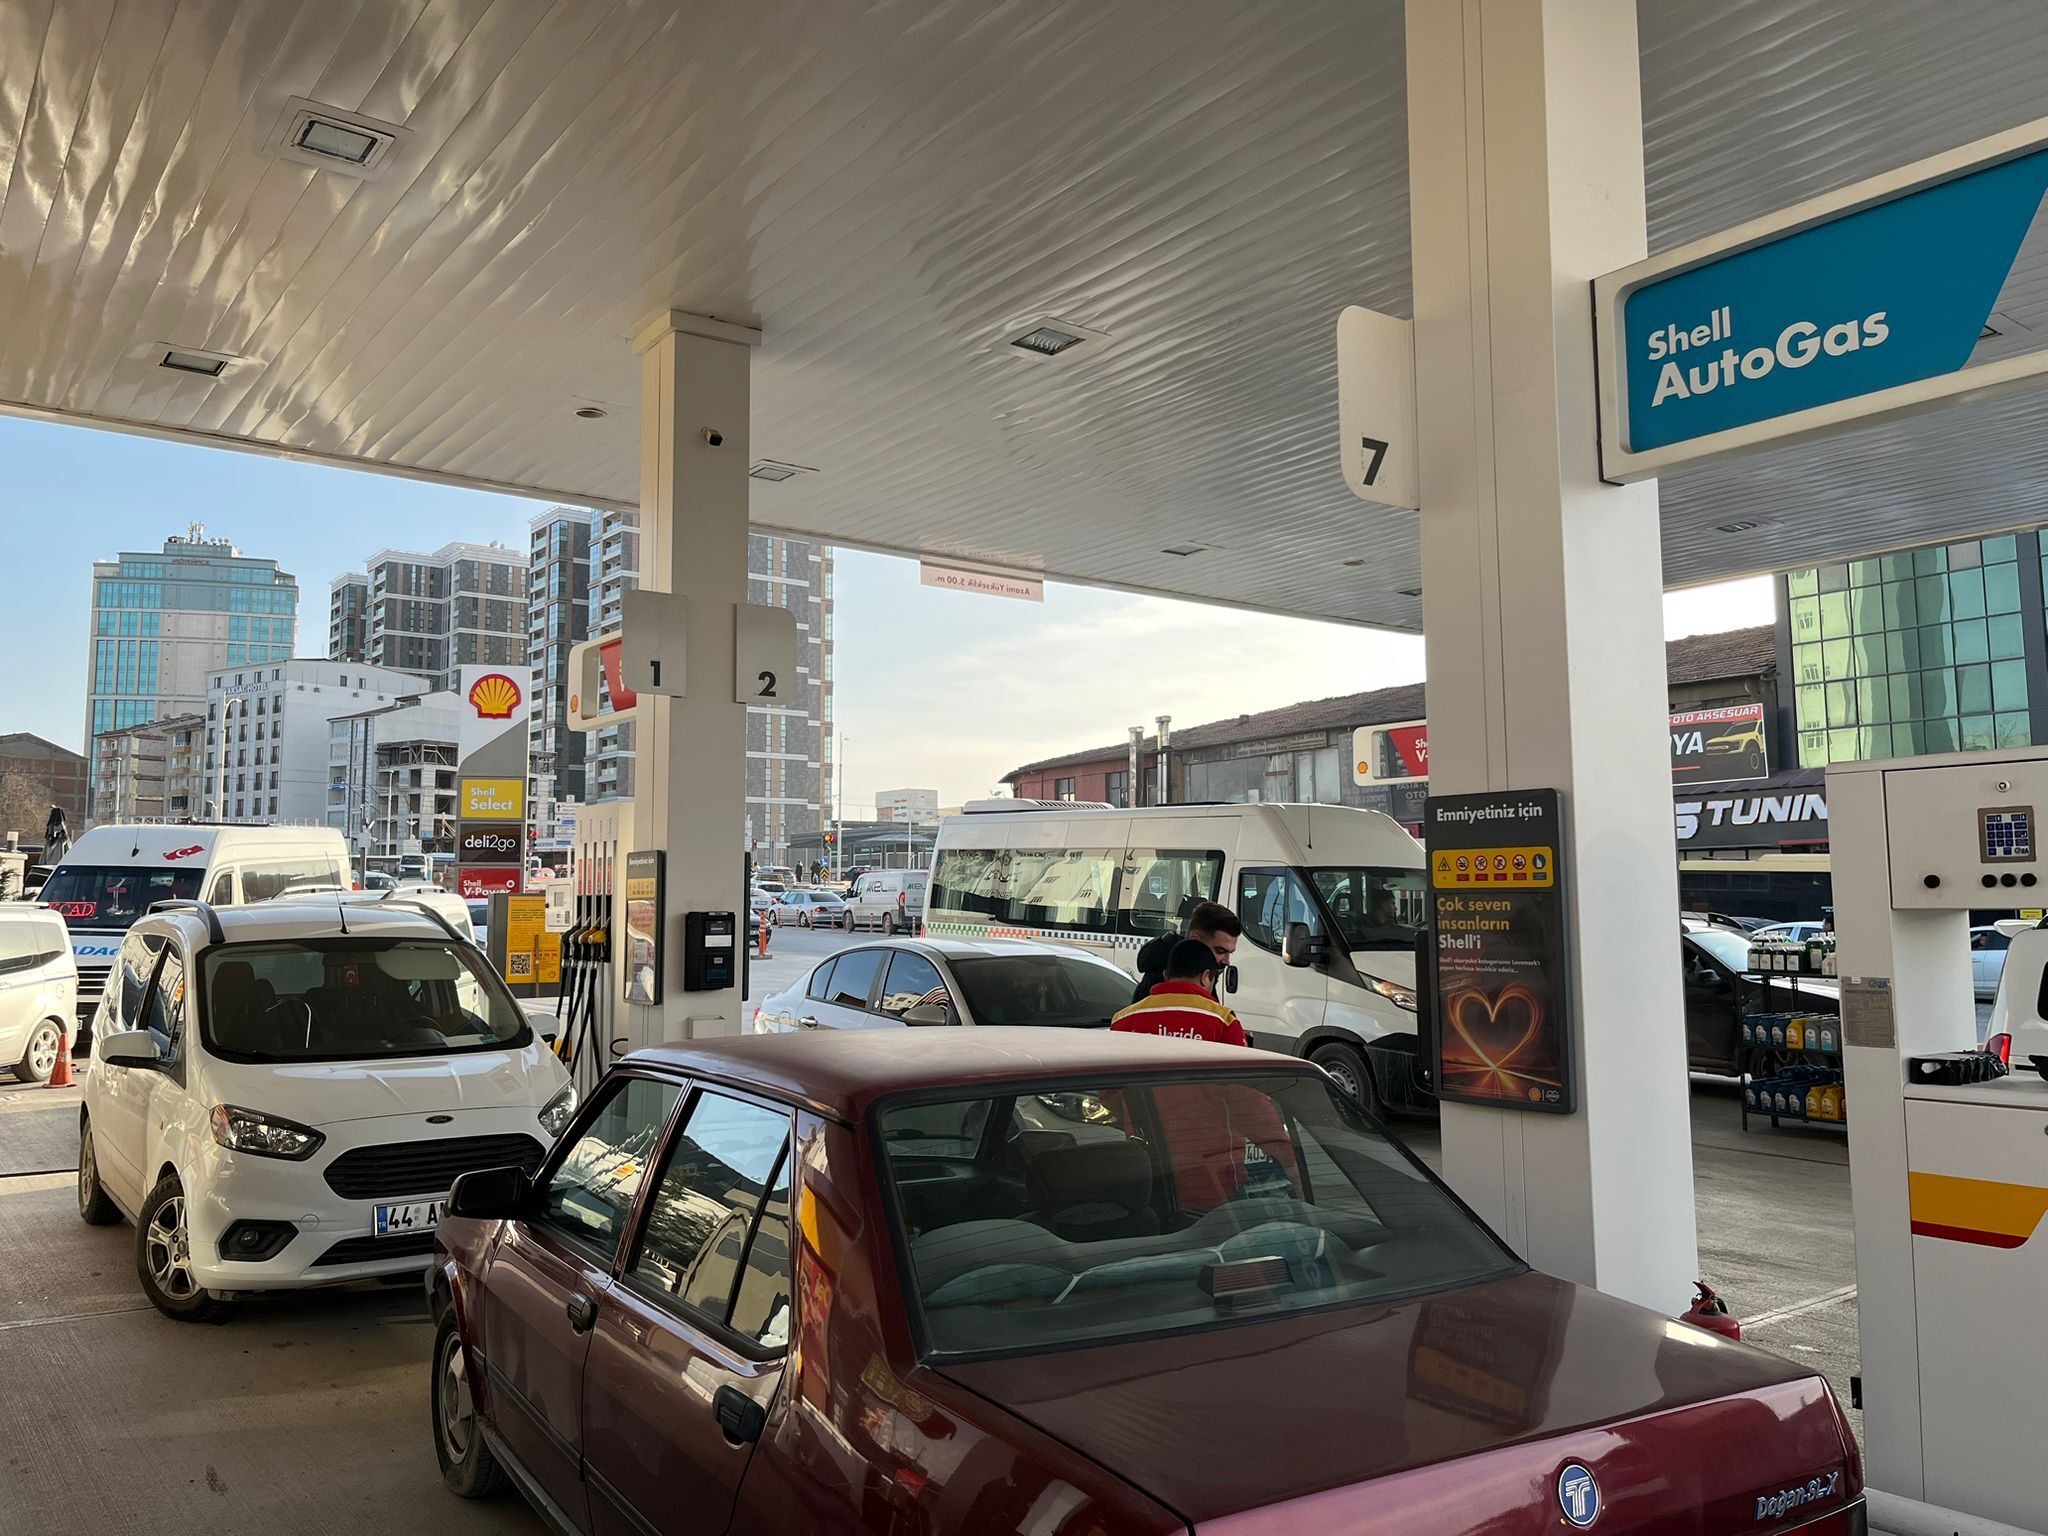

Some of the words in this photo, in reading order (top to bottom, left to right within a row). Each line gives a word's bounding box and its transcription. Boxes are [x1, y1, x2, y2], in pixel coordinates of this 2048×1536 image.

[1648, 306, 1731, 360] Shell
[1651, 311, 1890, 408] AutoGas
[1362, 436, 1389, 486] 7
[650, 660, 661, 687] 1
[758, 671, 777, 698] 2
[1672, 714, 1694, 724] OTO
[1696, 706, 1759, 721] AKSESUAR
[1415, 738, 1428, 749] Sh
[1671, 731, 1704, 755] YA
[471, 787, 496, 796] Shell
[1405, 791, 1426, 800] OTO
[470, 798, 513, 811] Select
[1436, 804, 1516, 825] Emniyetiniz
[1518, 801, 1543, 822] için
[464, 834, 516, 852] deli2go
[1436, 897, 1464, 915] Çok
[1468, 900, 1511, 911] seven
[1437, 915, 1510, 930] insanların
[1439, 933, 1481, 949] Shell'i
[388, 1206, 413, 1229] 44
[427, 1202, 444, 1225] A
[377, 1221, 387, 1229] TR
